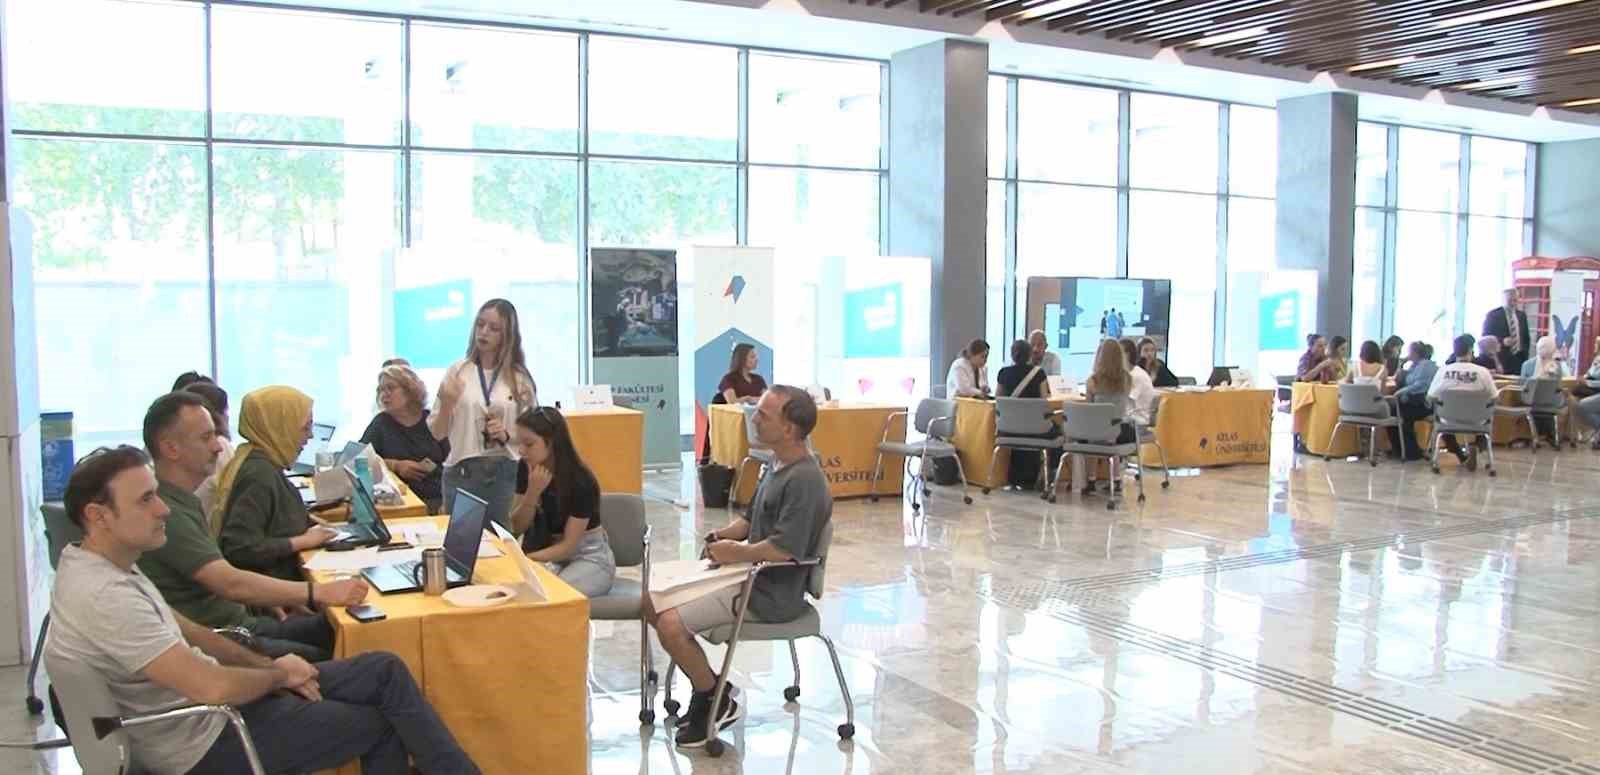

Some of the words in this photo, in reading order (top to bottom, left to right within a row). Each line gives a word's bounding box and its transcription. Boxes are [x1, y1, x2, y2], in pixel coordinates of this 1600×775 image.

[1443, 370, 1478, 384] ATLAS
[617, 383, 664, 394] FAKÜLTESİ
[1216, 431, 1239, 441] ATLAS
[818, 455, 841, 469] LAS
